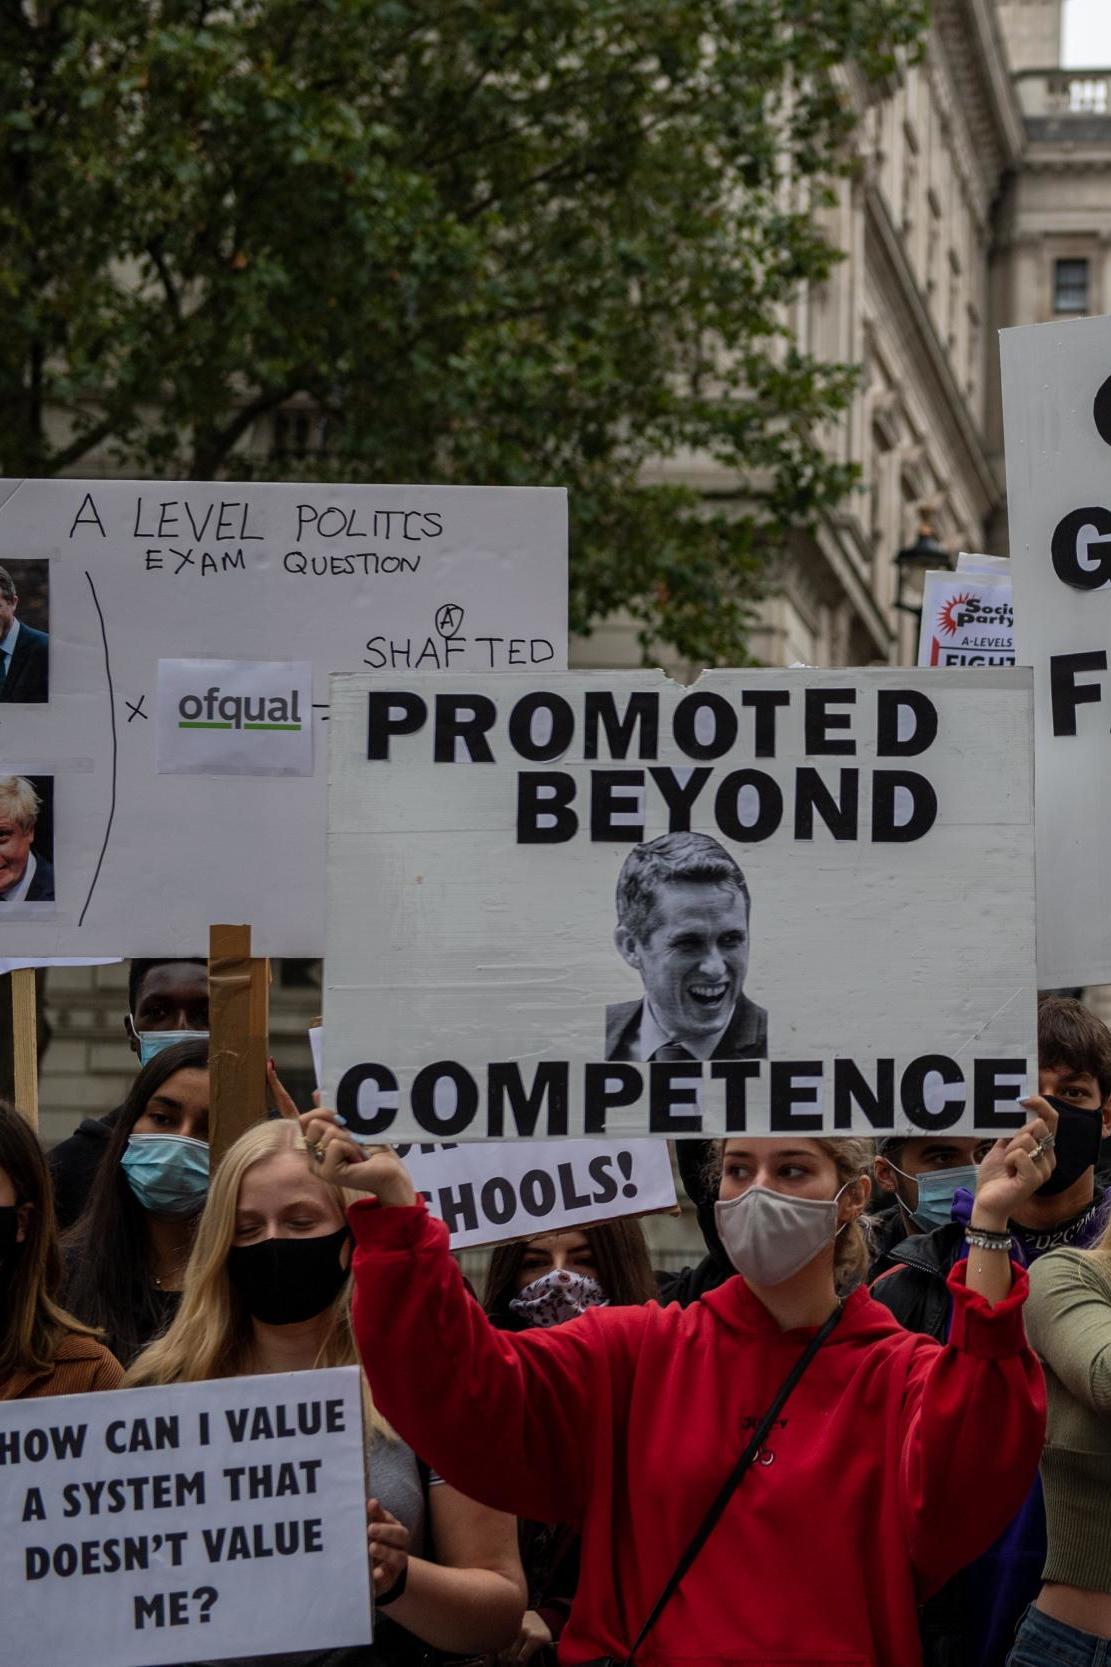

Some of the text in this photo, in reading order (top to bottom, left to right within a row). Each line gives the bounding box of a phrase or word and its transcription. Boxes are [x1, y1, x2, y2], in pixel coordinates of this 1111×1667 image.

[70, 493, 106, 538] A
[133, 497, 265, 542] LEVEL
[145, 548, 421, 575] EXAM QUESTION
[363, 636, 555, 669] SHAFTED
[961, 636, 1013, 648] A-LEVELS
[178, 687, 302, 730] ofqual
[366, 687, 939, 764] PROMOTED
[516, 766, 939, 844] BEYOND
[336, 1054, 1029, 1137] COMPETENCE
[416, 1151, 639, 1233] HOOLS!
[0, 1399, 346, 1466] HOW CAN I VALUE
[22, 1459, 322, 1522] A SYSTEM THAT
[25, 1518, 324, 1581] DOESN'T VALUE
[133, 1586, 219, 1630] ME?
